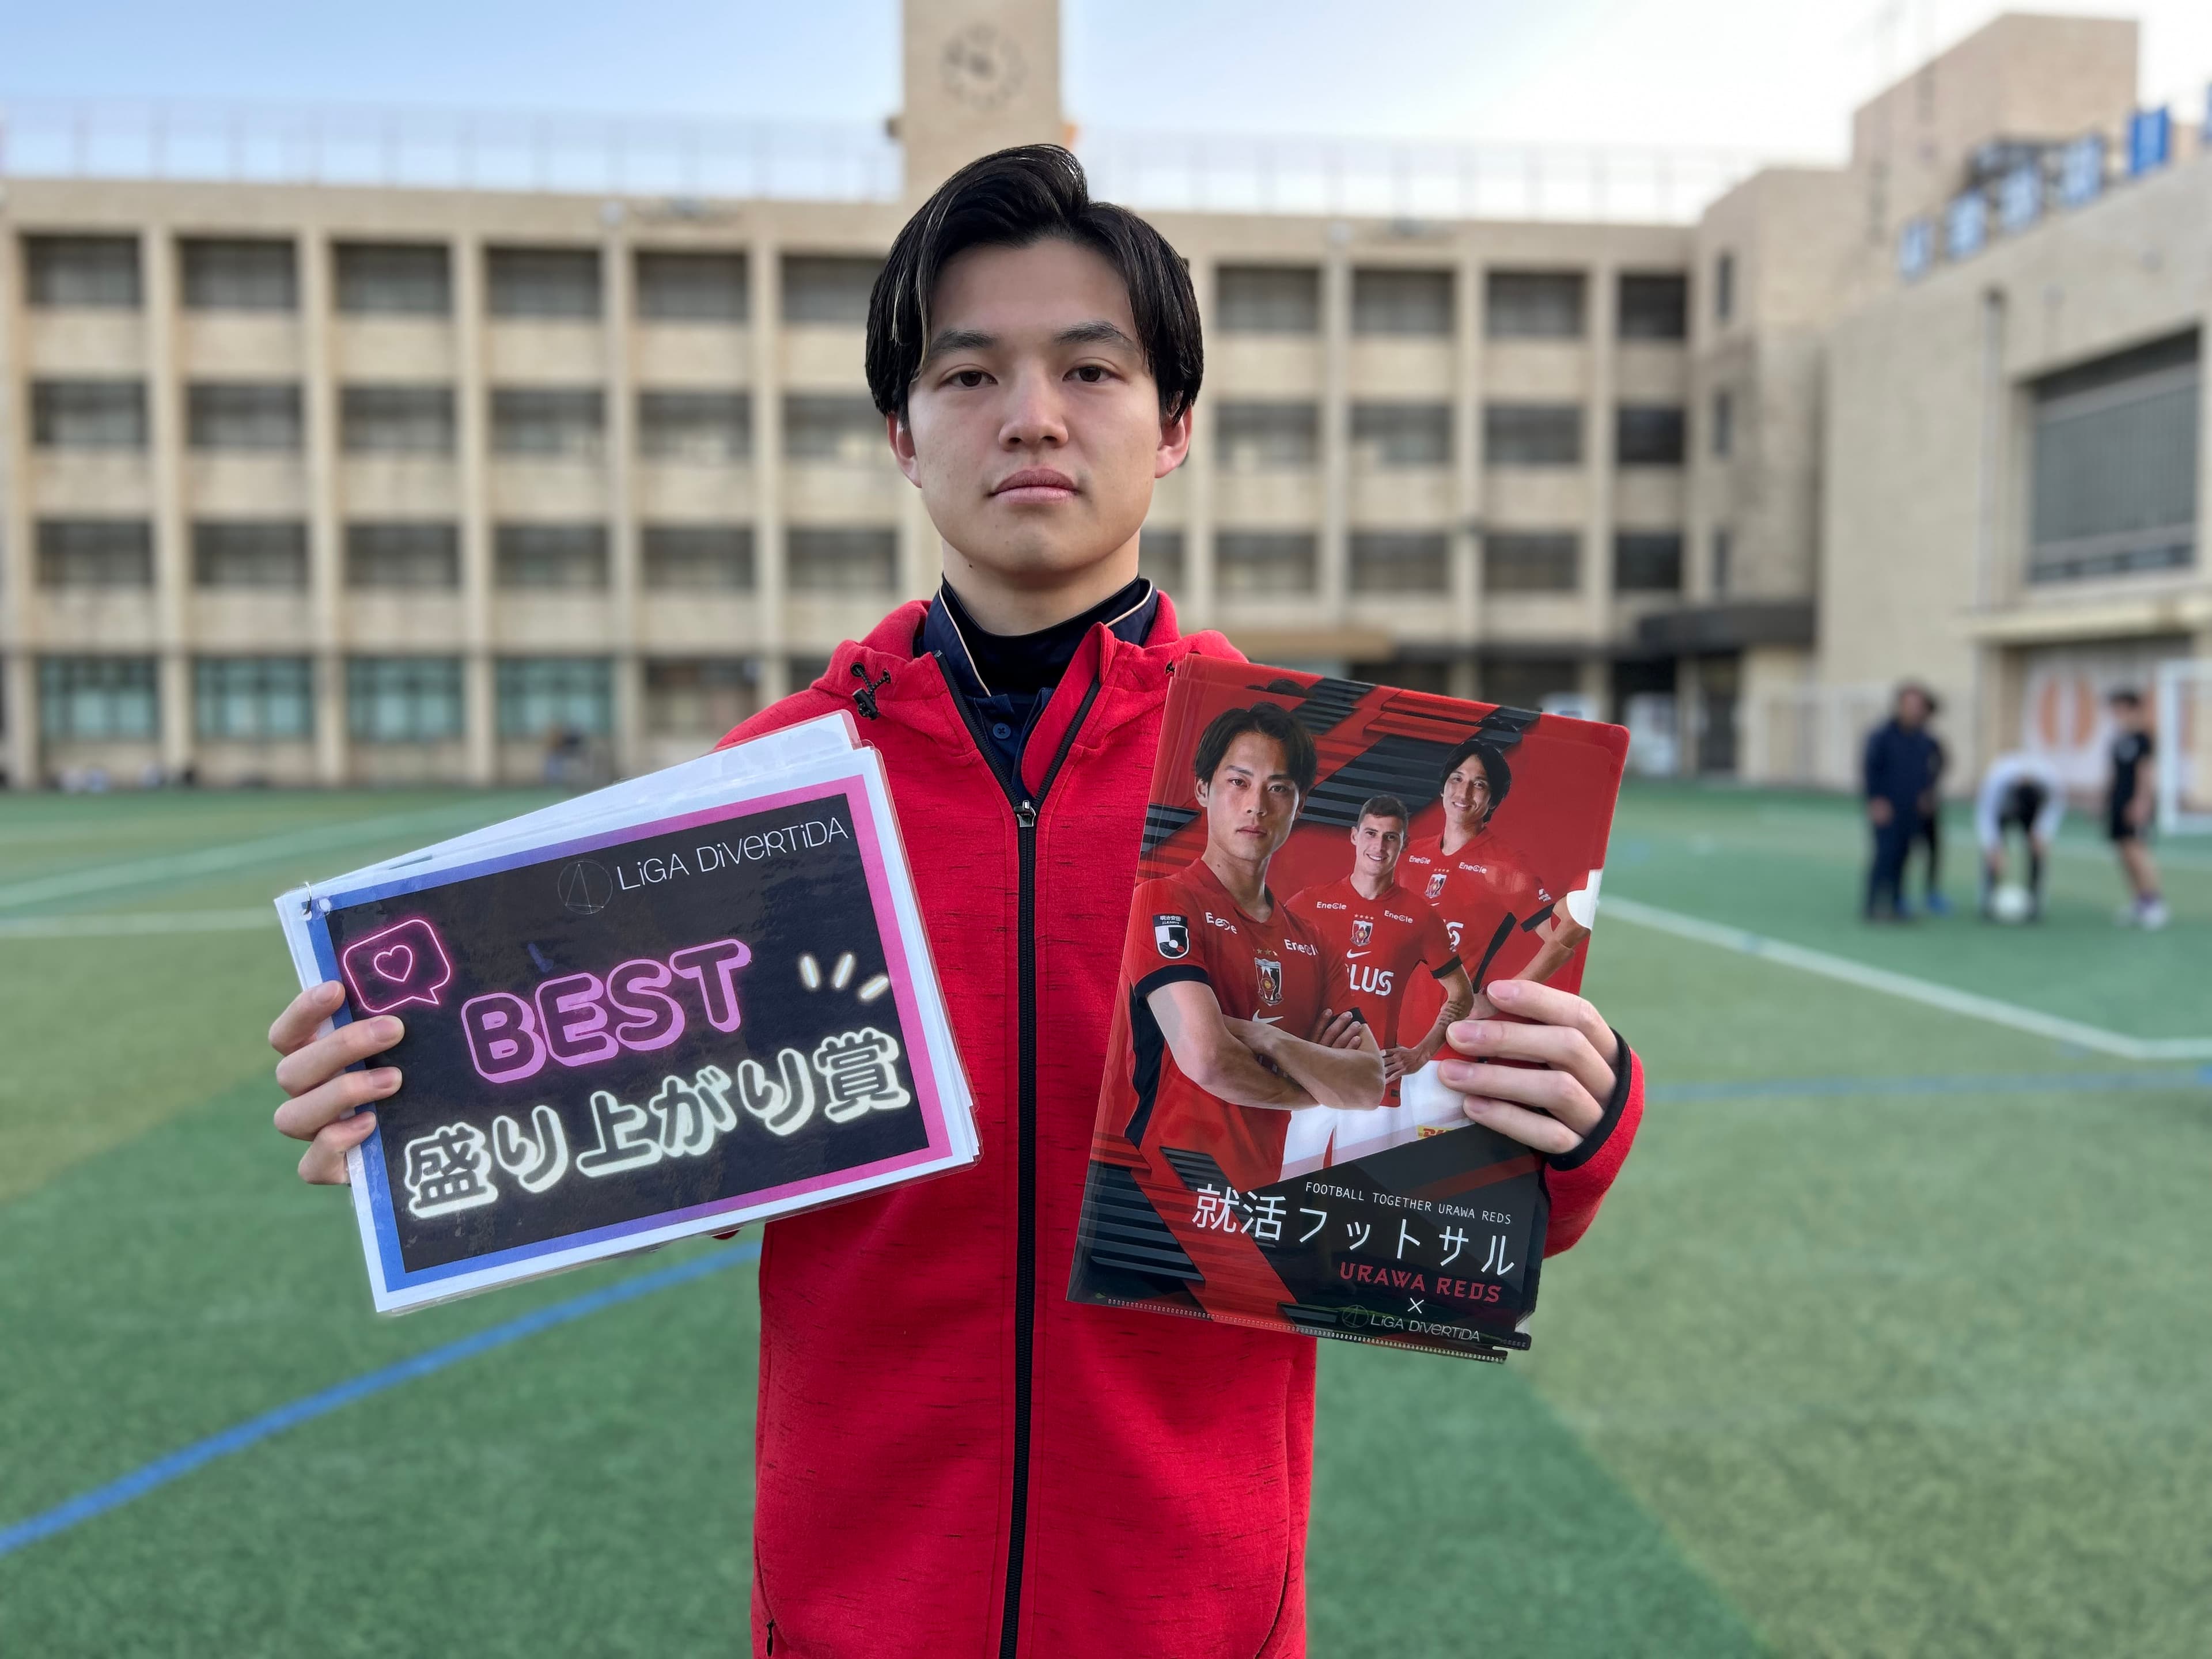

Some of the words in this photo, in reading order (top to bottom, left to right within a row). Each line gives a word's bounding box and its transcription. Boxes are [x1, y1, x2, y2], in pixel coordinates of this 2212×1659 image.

[1284, 939, 1319, 956] EneCl
[1345, 963, 1394, 996] LUS
[461, 938, 752, 1084] BEST
[404, 1027, 911, 1219] 盛り上がり賞
[1305, 1181, 1365, 1201] FOOTBALL
[1372, 1192, 1432, 1212] TOGETHER
[1438, 1203, 1475, 1219] URAWA
[1482, 1210, 1512, 1225] REDS
[1191, 1184, 1515, 1276] 就活フットサル
[1339, 1261, 1426, 1291] URAWA
[1436, 1277, 1502, 1303] REDS
